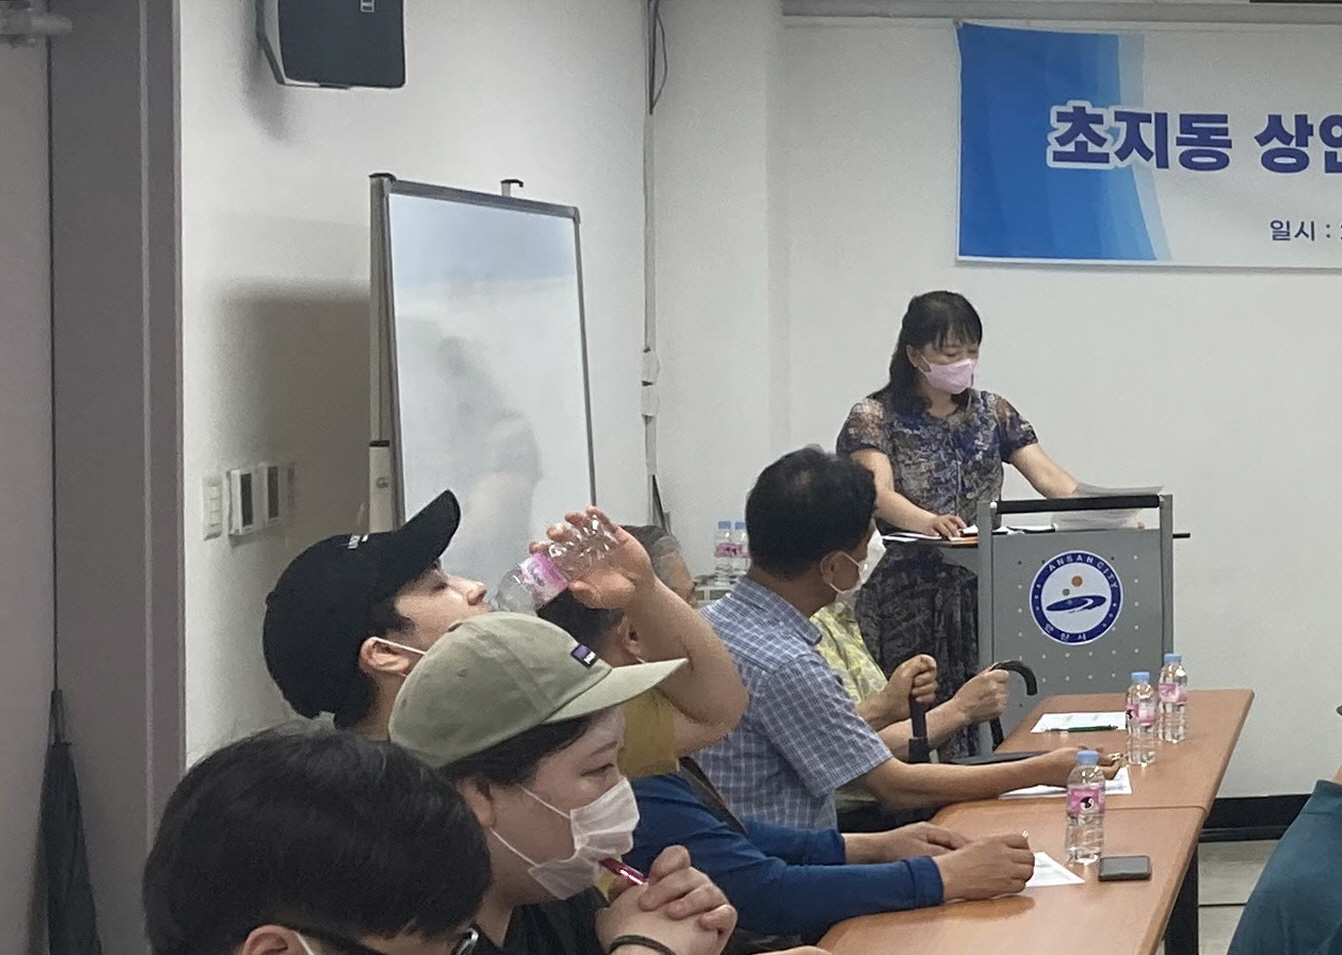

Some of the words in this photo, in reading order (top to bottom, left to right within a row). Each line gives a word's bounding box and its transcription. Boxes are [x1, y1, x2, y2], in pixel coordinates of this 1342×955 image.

[1052, 105, 1233, 172] 초지동
[1270, 219, 1315, 241] 일시
[1048, 554, 1095, 573] ANSAN
[1096, 562, 1119, 588] CITY
